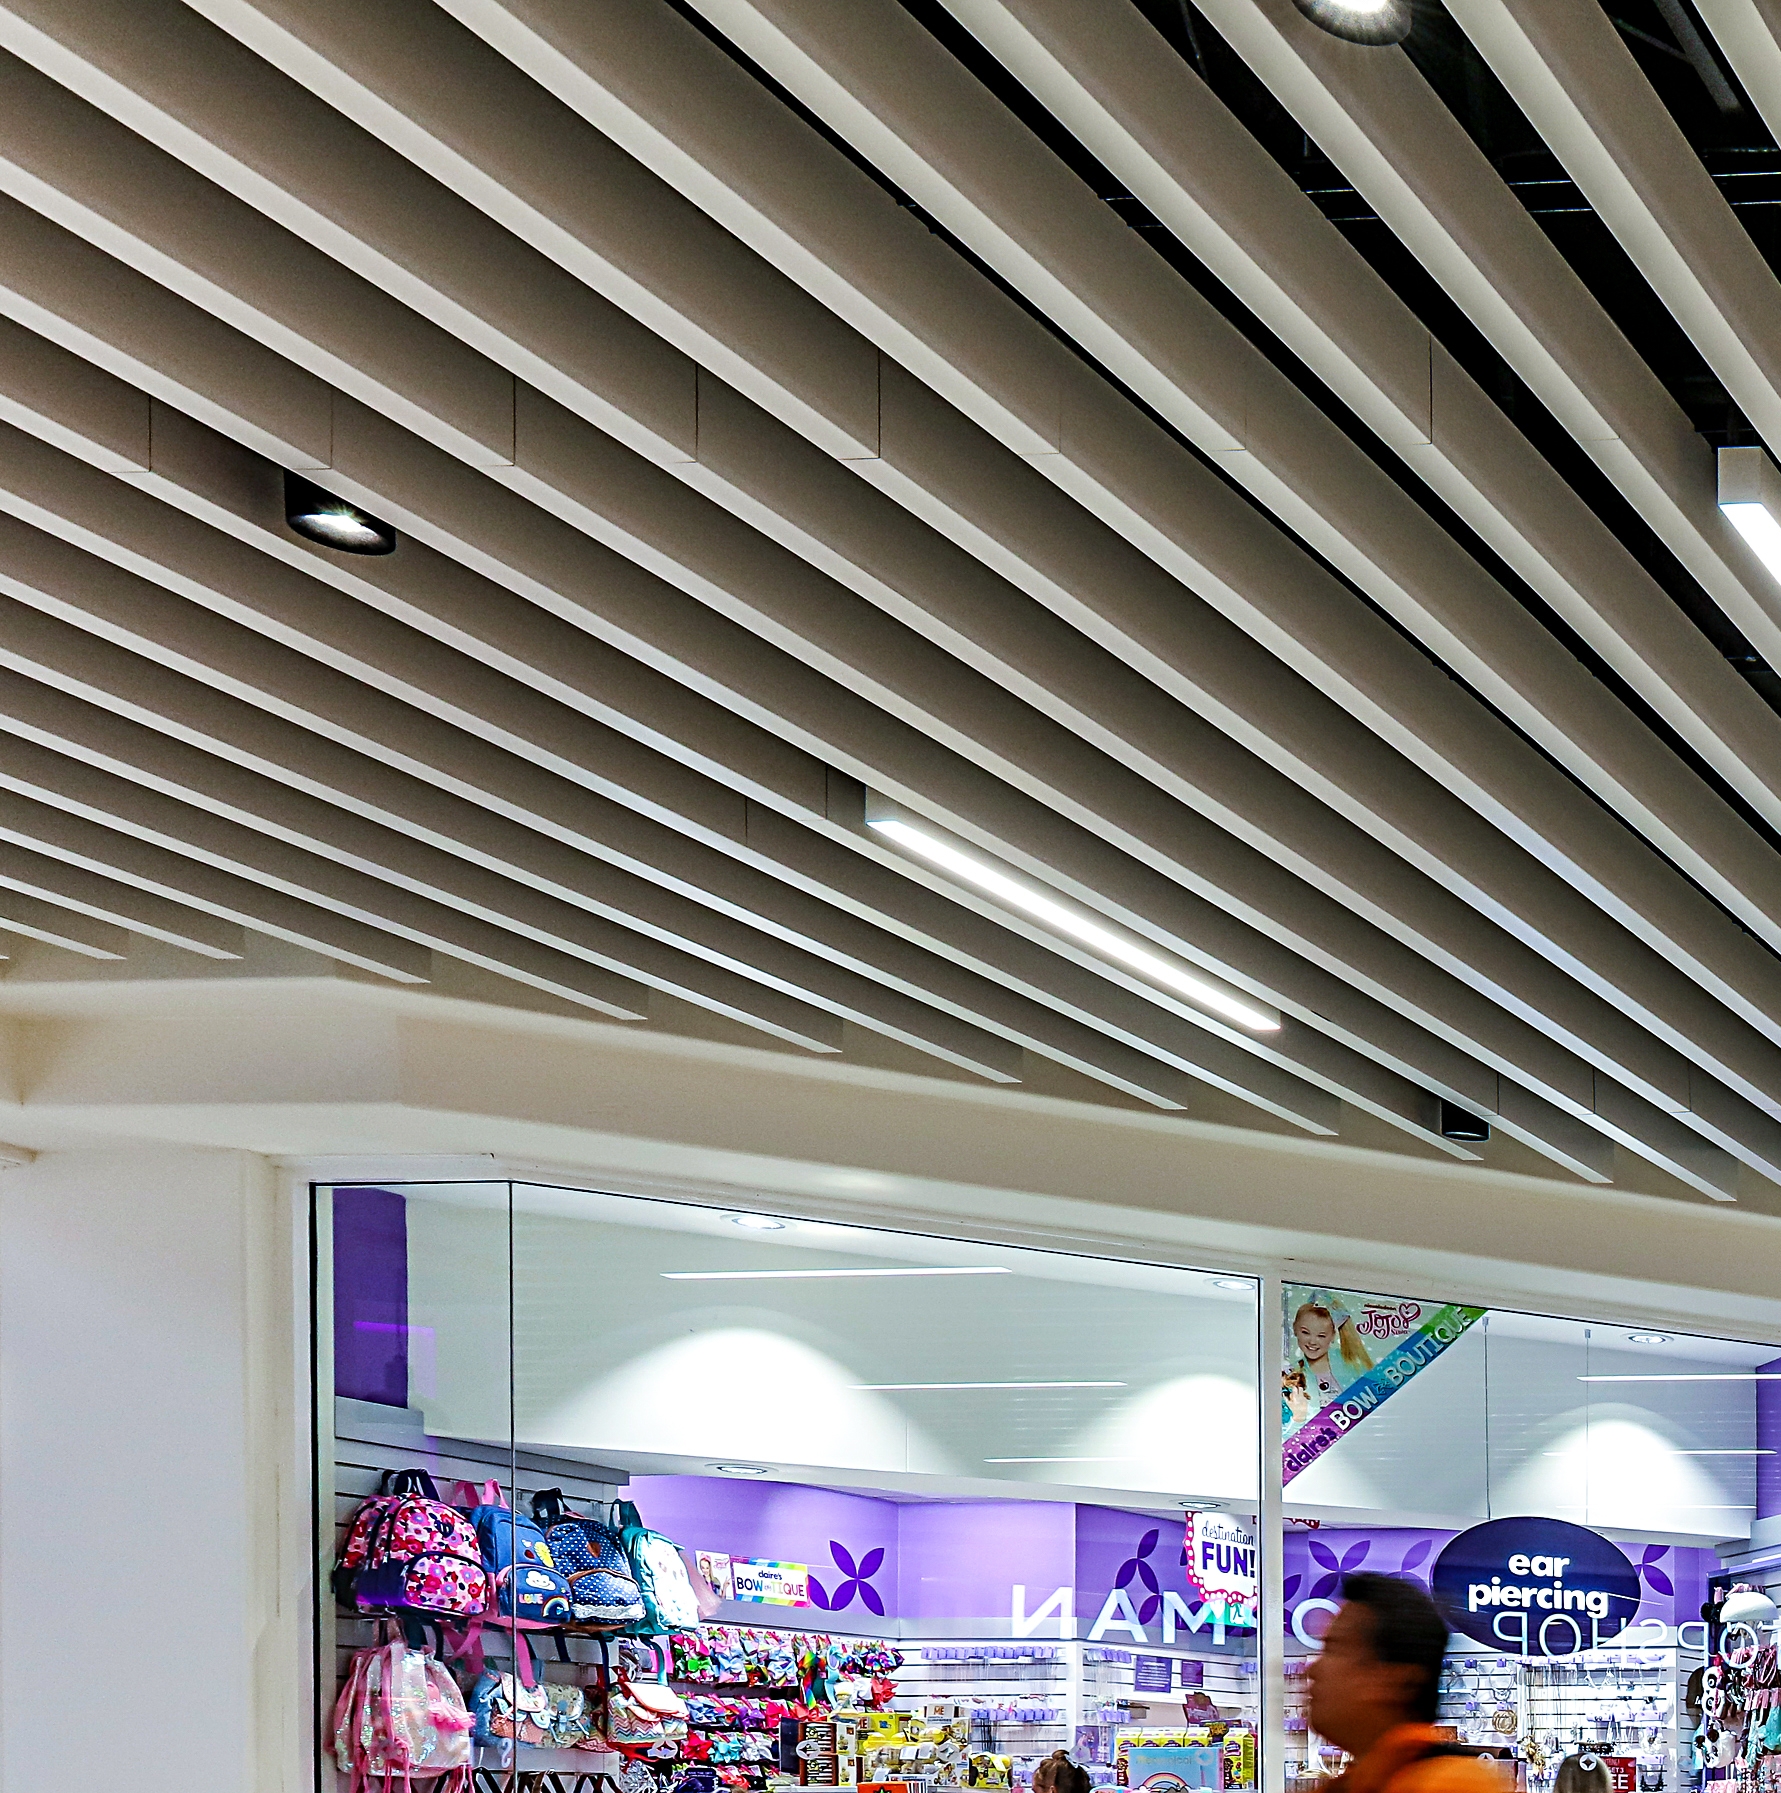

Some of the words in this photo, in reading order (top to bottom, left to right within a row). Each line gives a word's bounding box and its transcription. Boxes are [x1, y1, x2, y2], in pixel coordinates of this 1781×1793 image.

[1285, 1426, 1338, 1472] claire's
[1328, 1386, 1380, 1431] BOW
[1384, 1308, 1474, 1388] BOUTIQUE
[1202, 1520, 1255, 1547] destination
[1202, 1541, 1256, 1579] FUN!
[1507, 1553, 1571, 1578] ear
[736, 1577, 763, 1592] BOW
[757, 1570, 782, 1581] claire's
[1467, 1576, 1610, 1619] piercing
[1610, 1773, 1629, 1790] EE
